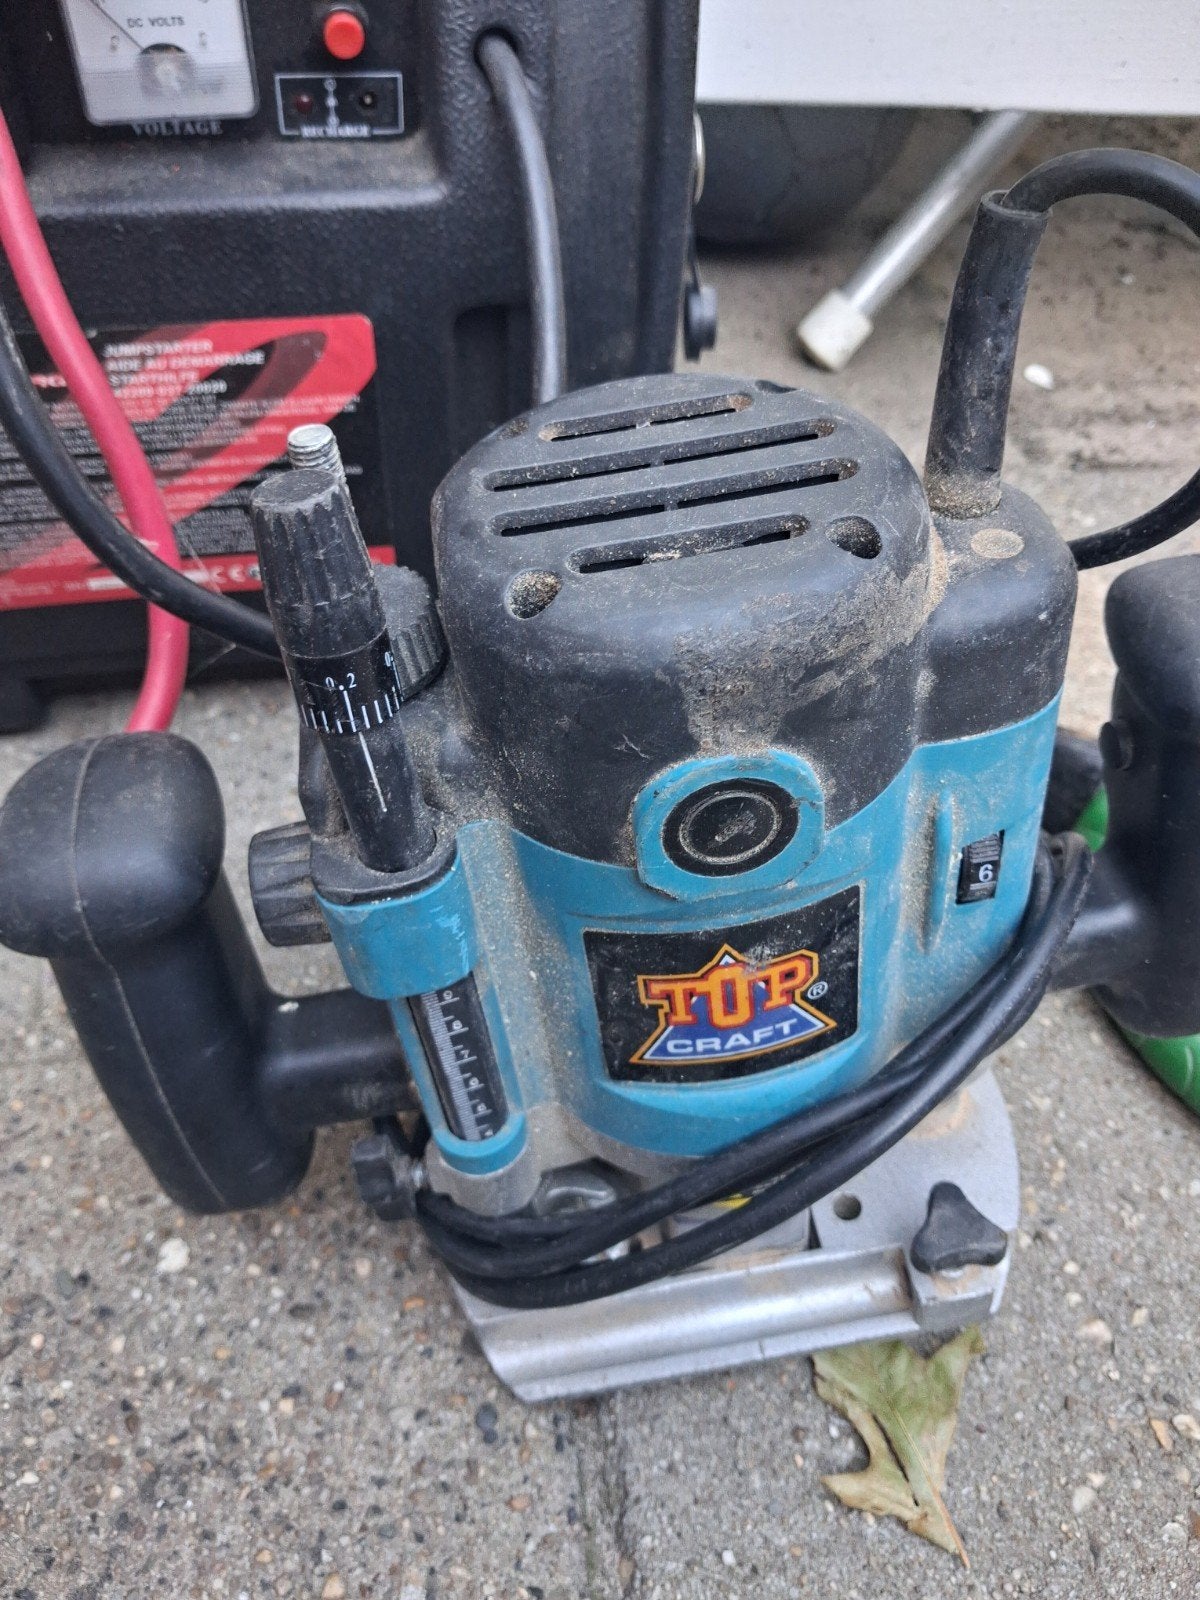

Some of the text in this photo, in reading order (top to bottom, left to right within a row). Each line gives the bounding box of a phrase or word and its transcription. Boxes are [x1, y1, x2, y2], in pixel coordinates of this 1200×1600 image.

[127, 16, 185, 28] DC VOLTS
[133, 120, 223, 138] VOLTAGE
[103, 340, 213, 357] JUMPSTARTER
[105, 357, 143, 371] AIDE
[145, 356, 168, 370] AU
[977, 863, 993, 883] 6
[645, 954, 813, 1029] TOP
[666, 1017, 799, 1055] CRAFT
